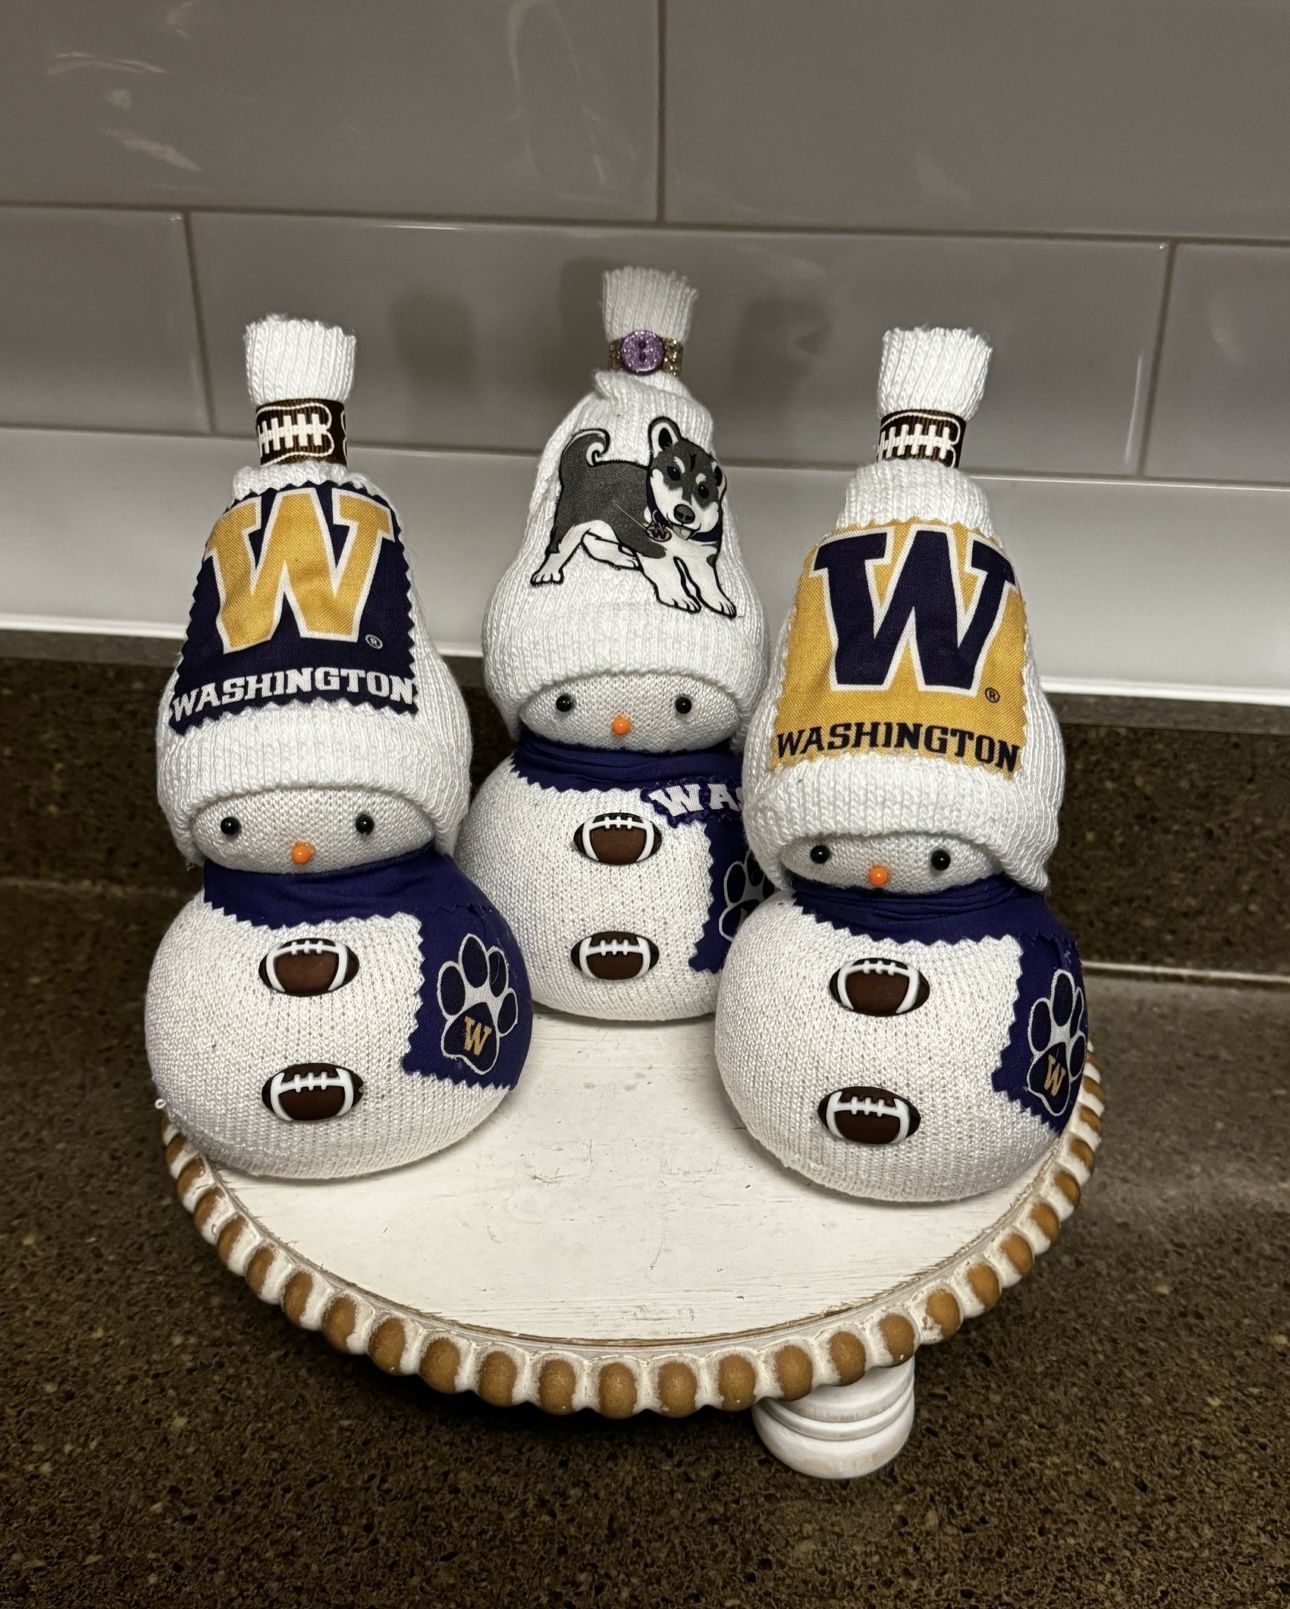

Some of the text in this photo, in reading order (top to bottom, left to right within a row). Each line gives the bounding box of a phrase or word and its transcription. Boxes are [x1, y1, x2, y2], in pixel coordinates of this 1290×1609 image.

[204, 488, 394, 653] W
[809, 525, 1019, 695] W
[173, 668, 416, 721] WASHINGTON
[777, 722, 1020, 773] WASHINGTON
[649, 784, 742, 817] WA
[464, 1016, 492, 1056] W
[1044, 1055, 1066, 1096] W
